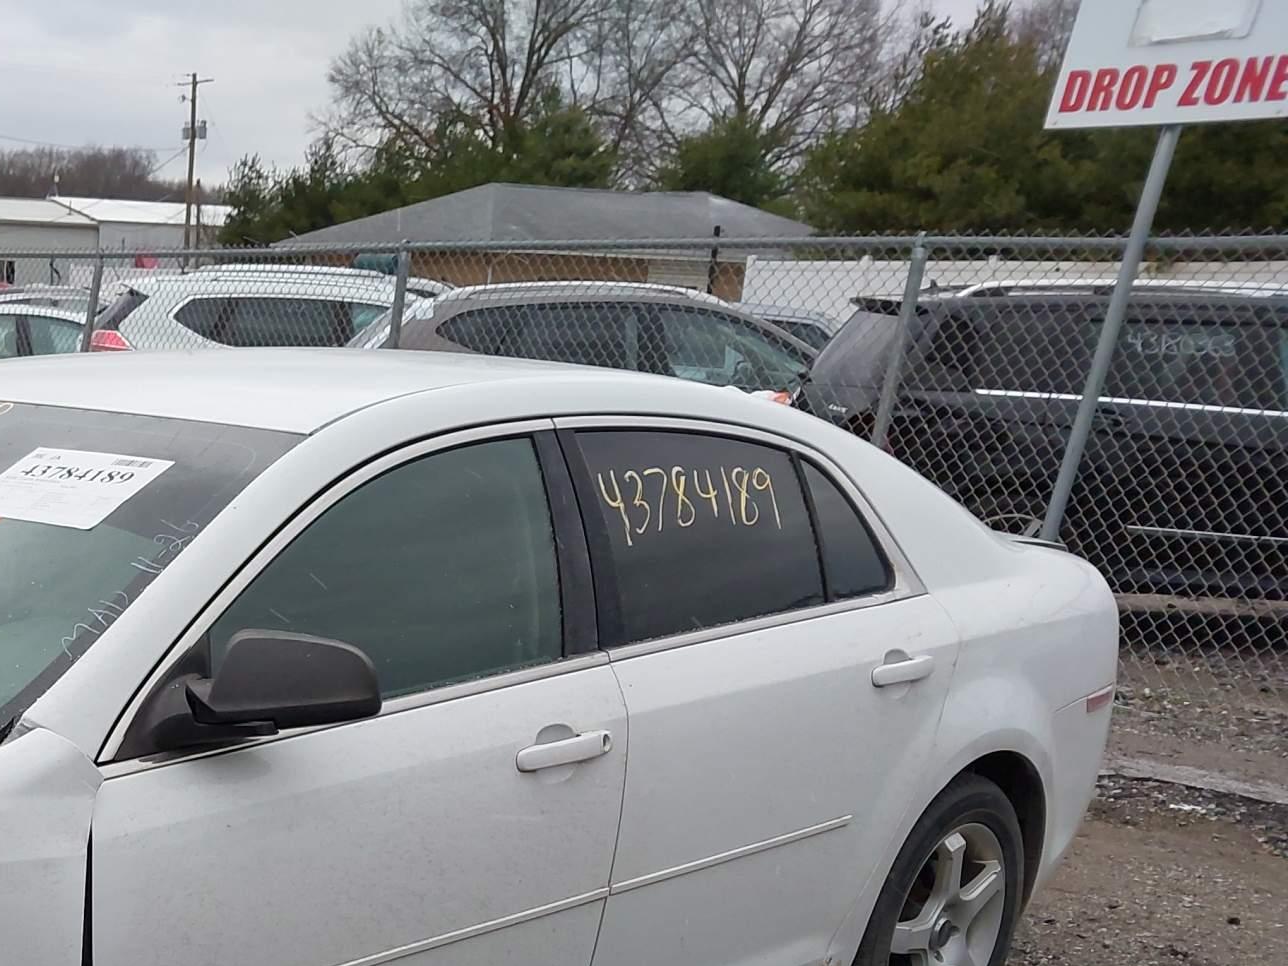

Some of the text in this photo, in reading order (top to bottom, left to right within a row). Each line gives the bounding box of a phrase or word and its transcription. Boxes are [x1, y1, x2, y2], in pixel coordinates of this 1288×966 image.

[1058, 54, 1288, 113] DROP ZONE
[20, 463, 136, 485] 43784189
[597, 465, 782, 547] 43784189
